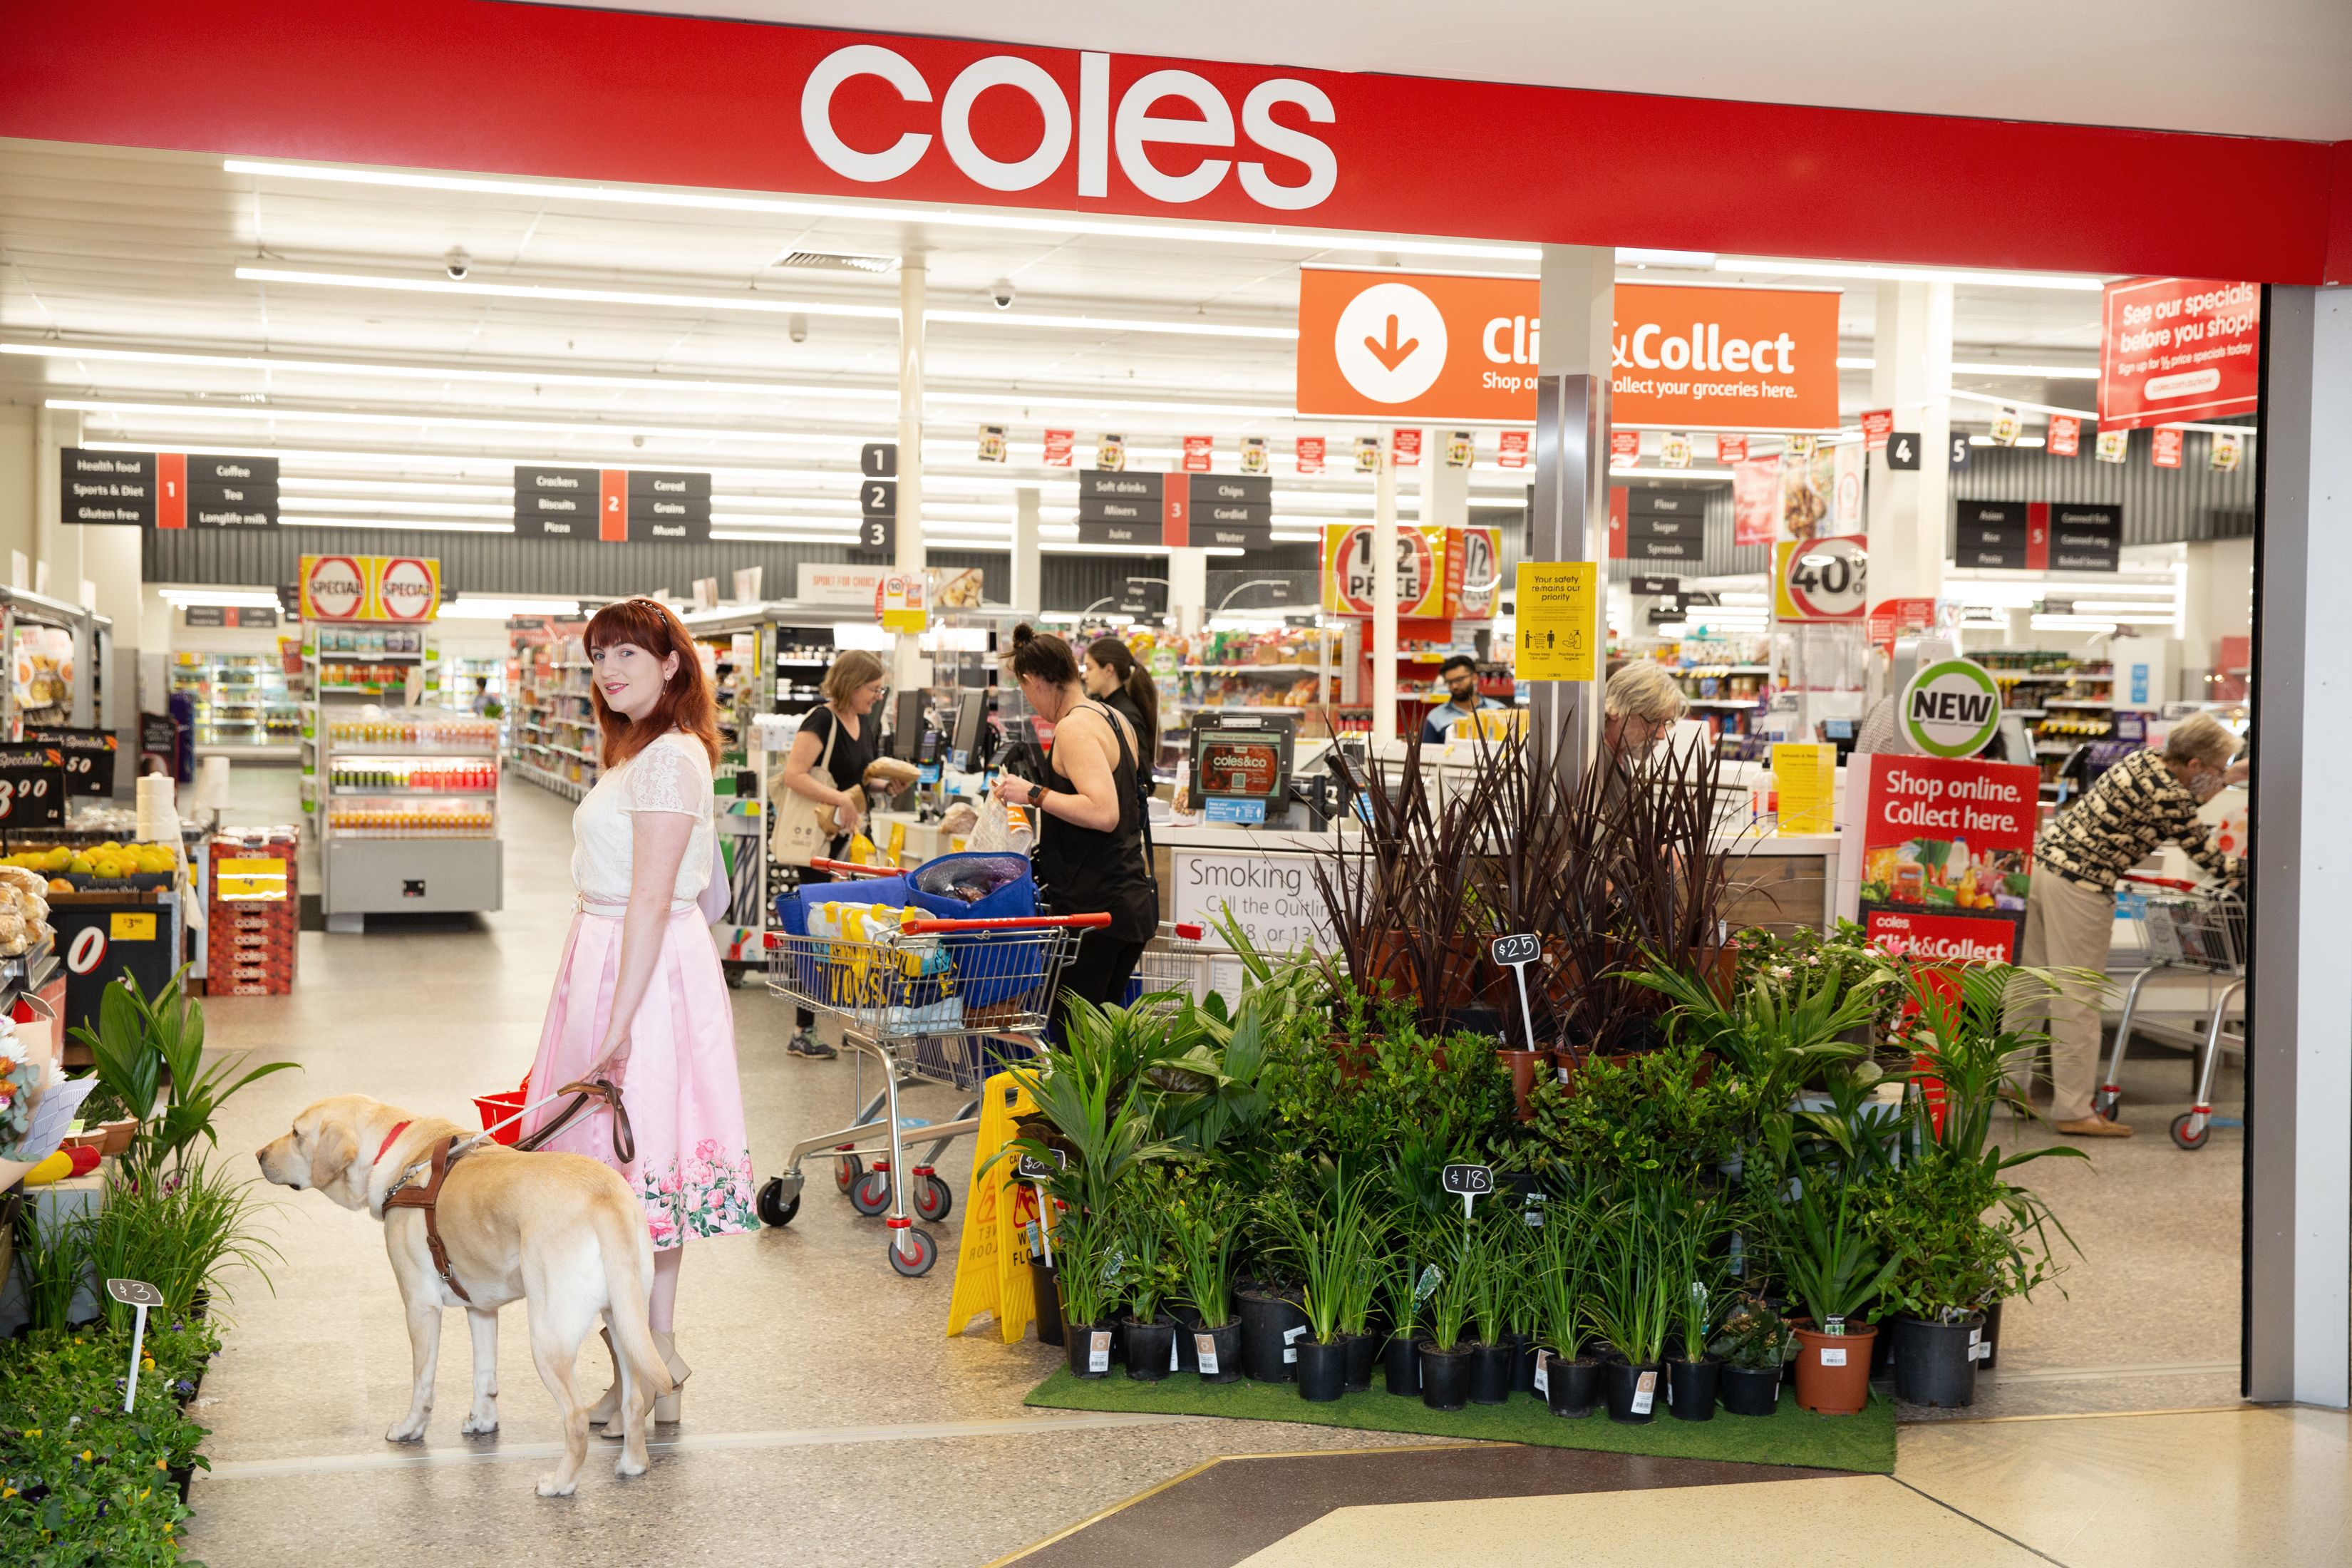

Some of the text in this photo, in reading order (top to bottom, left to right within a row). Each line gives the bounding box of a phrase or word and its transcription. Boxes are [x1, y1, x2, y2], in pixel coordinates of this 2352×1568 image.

[801, 44, 1338, 210] coles
[2123, 281, 2254, 326] See our specials
[2120, 308, 2254, 354] before you shop!
[2118, 362, 2136, 377] Sign
[2136, 360, 2148, 373] up
[2148, 358, 2160, 370] for
[2170, 354, 2192, 369] price
[2193, 345, 2227, 365] specials
[2227, 342, 2253, 356] today
[1482, 371, 1521, 394] Shop
[1656, 381, 1688, 398] your
[1693, 382, 1759, 400] groceries
[1762, 384, 1797, 398] here.
[1895, 438, 1912, 463] 4
[1952, 438, 1966, 463] 5
[76, 459, 141, 473] Health food
[872, 449, 884, 471] 1
[215, 465, 251, 478] Coffee
[165, 480, 175, 498] 1
[536, 475, 579, 489] Crackers
[654, 480, 686, 492] Cereal
[1095, 481, 1147, 495] Soft drinks
[73, 483, 144, 497] Sports & Diet
[222, 488, 244, 500] Tea
[871, 486, 886, 508] 2
[1217, 485, 1245, 499] Chips
[538, 498, 577, 511] Biscuits
[607, 495, 619, 512] 2
[653, 502, 686, 515] Grains
[1170, 502, 1182, 519] 3
[1654, 498, 1679, 510] Flour
[78, 507, 140, 521] Gluten free
[1104, 505, 1138, 517] Mixers
[1213, 507, 1249, 521] Cordial
[1979, 510, 2005, 522] Asian
[199, 512, 268, 526] Longlife milk
[1609, 515, 1620, 531] 4
[544, 521, 571, 534] Pizza
[652, 524, 686, 537] Muesli
[1108, 528, 1133, 540] Juice
[1652, 520, 1681, 535] Sugar
[870, 524, 885, 546] 3
[1215, 531, 1247, 544] Water
[1981, 531, 2001, 543] Rice
[2032, 528, 2043, 545] 5
[1646, 542, 1684, 556] Spreads
[1978, 552, 2003, 565] Pasta
[2057, 555, 2112, 569] Baked beans
[1535, 575, 1579, 584] Your safety
[309, 579, 364, 597] SPECIAL
[382, 580, 433, 599] SPECIAL
[1541, 593, 1570, 602] priority
[1912, 689, 1994, 723] NEW
[66, 756, 92, 774] 50
[1213, 755, 1267, 768] coles&co
[1886, 770, 2022, 803] Shop online.
[1884, 800, 2019, 833] Collect here.
[1190, 858, 1301, 897] Smoking
[1243, 896, 1269, 915] the
[1274, 898, 1331, 919] Quitlin
[234, 917, 269, 929] coles
[1876, 915, 1911, 929] coles
[234, 934, 269, 946] coles
[1267, 928, 1285, 942] or
[1292, 926, 1311, 942] 13
[66, 926, 107, 975] 0
[1498, 936, 1535, 958] $25
[233, 951, 268, 962] coles
[232, 967, 267, 979] coles
[232, 984, 267, 996] coles
